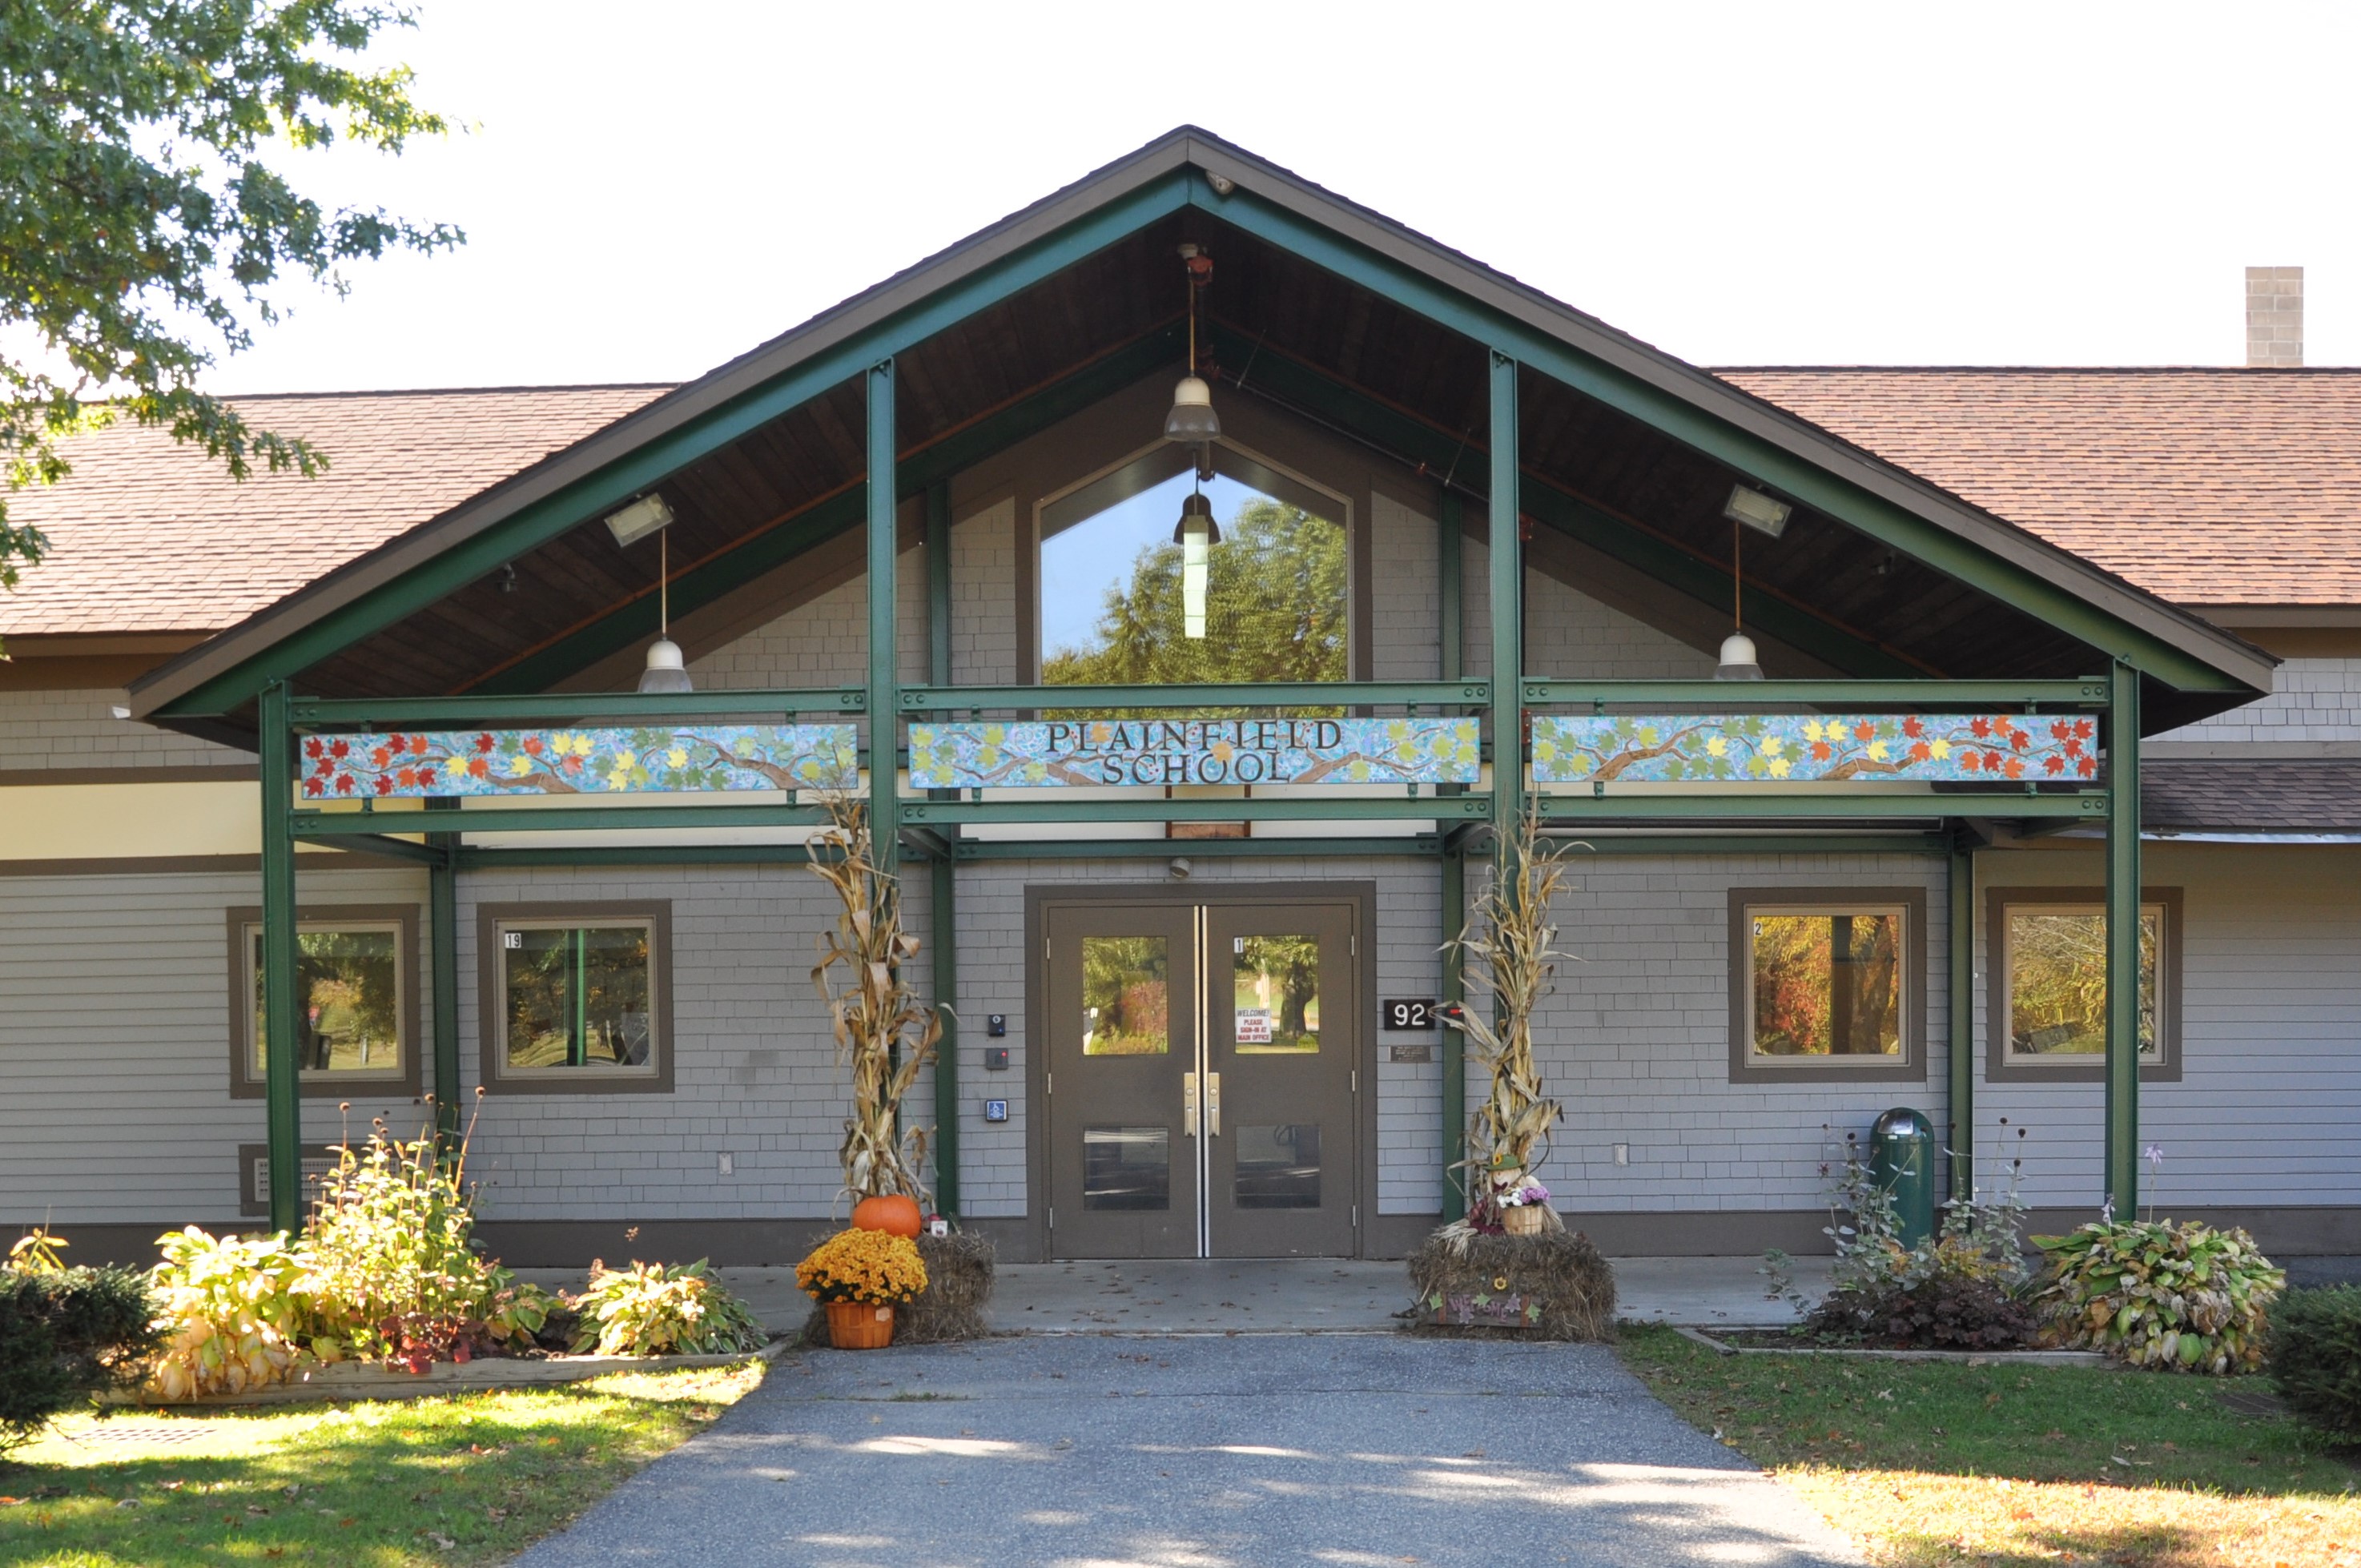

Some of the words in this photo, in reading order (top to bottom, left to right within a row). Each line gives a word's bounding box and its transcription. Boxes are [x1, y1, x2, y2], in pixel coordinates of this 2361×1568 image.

[1046, 720, 1343, 753] PLAINFIELD
[1102, 751, 1291, 784] SCHOOL
[509, 934, 520, 947] 19
[1755, 923, 1761, 935] 2
[1237, 939, 1242, 952] 1
[1394, 1003, 1426, 1026] 92
[1448, 1294, 1507, 1322] WEOME
